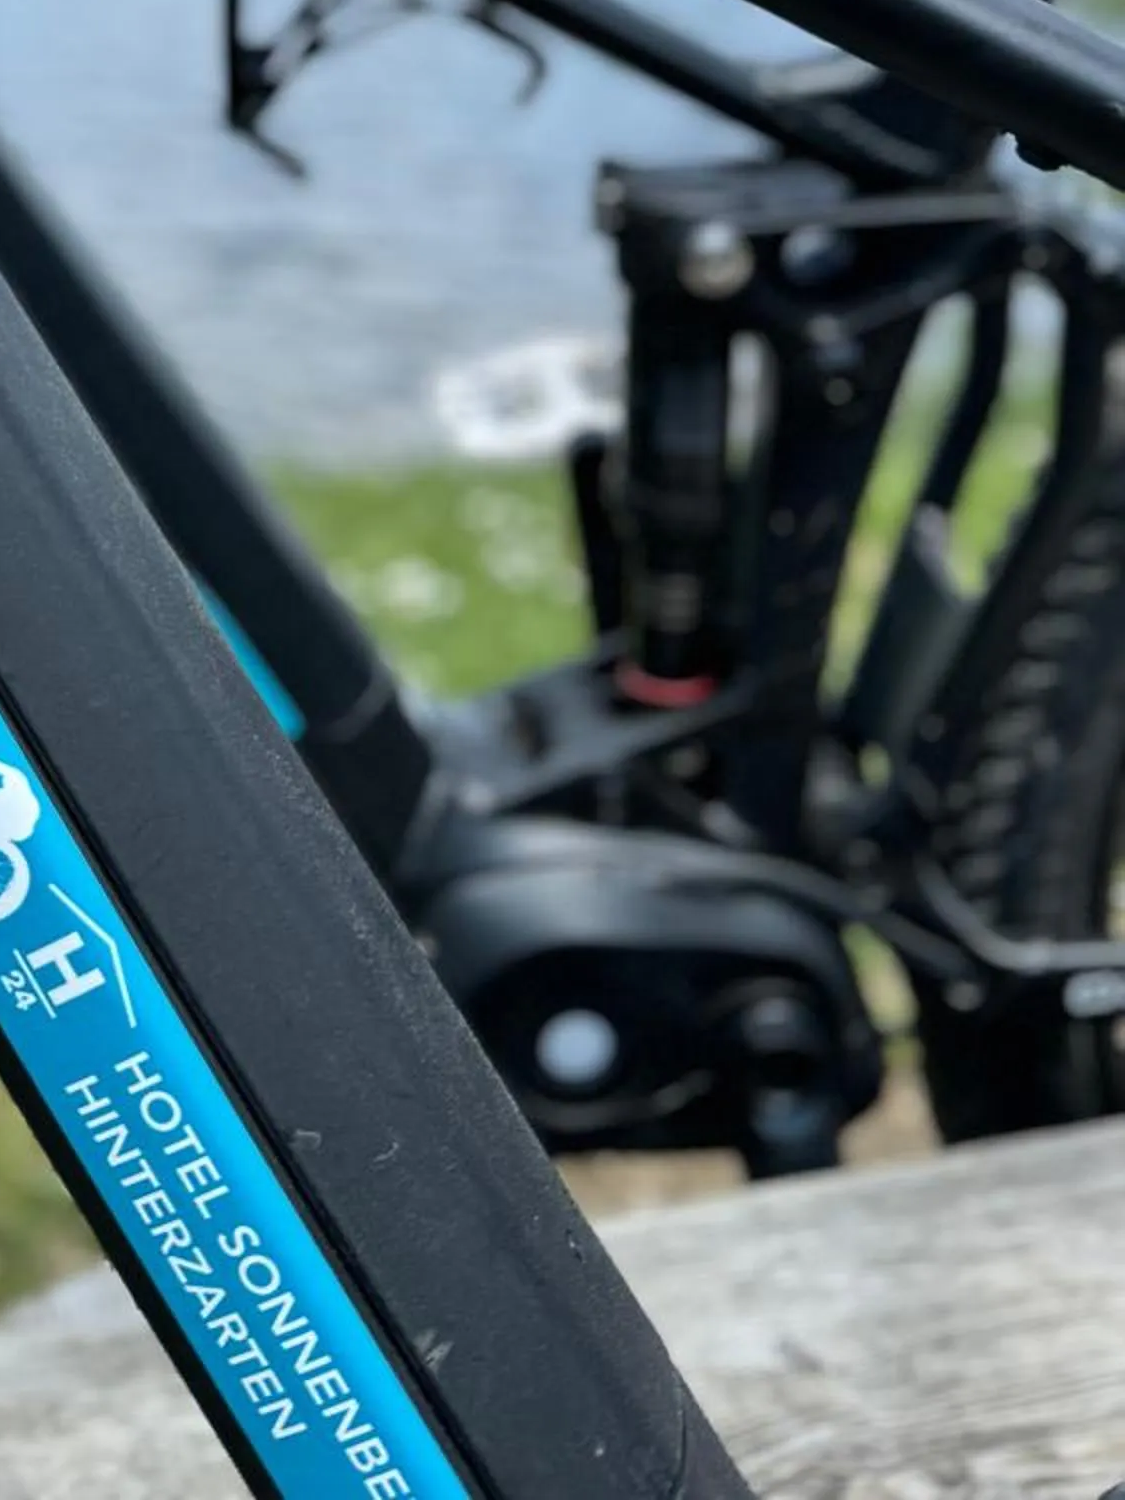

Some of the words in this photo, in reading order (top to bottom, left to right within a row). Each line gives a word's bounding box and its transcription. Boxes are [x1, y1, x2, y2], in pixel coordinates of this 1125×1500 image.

[0, 970, 37, 1011] 24
[26, 931, 106, 1007] H
[64, 1074, 308, 1441] HINTERZARTEN
[114, 1050, 232, 1221] HOTEL
[218, 1224, 417, 1500] SONNENBE
